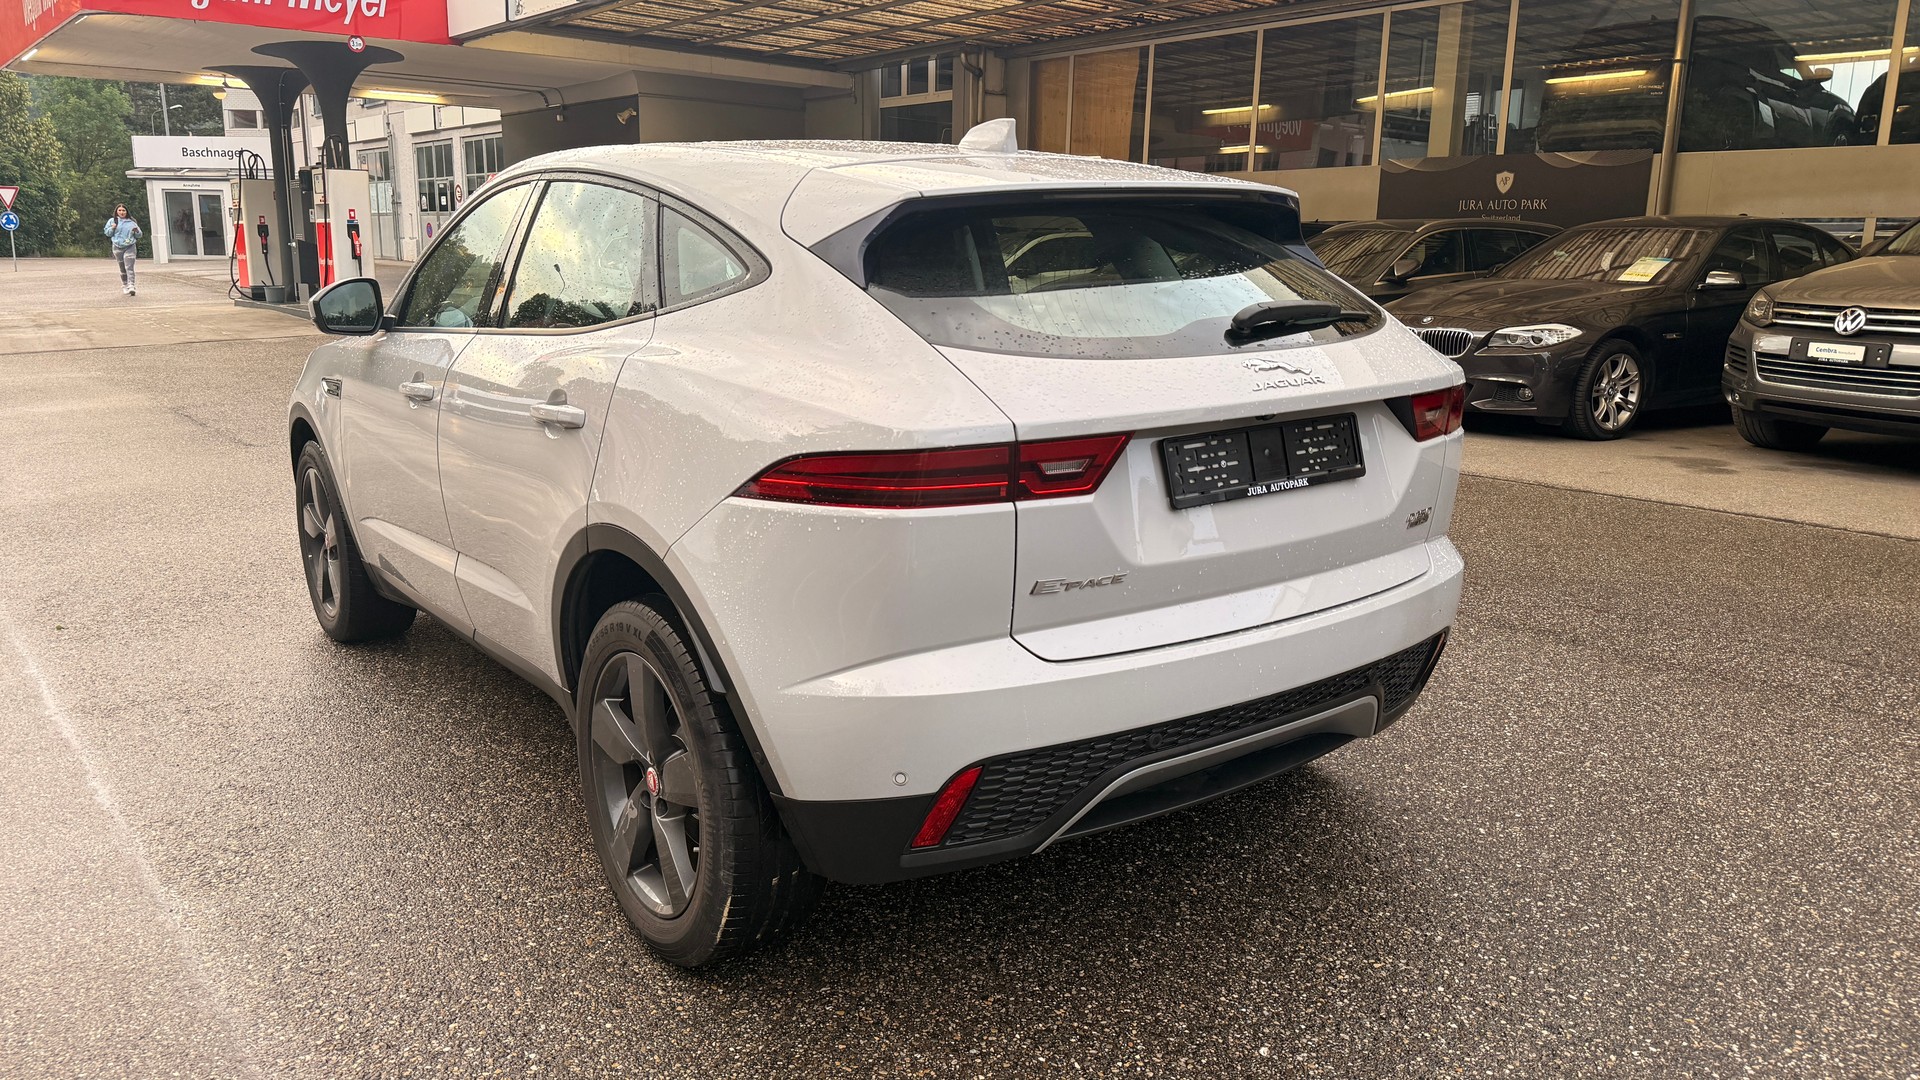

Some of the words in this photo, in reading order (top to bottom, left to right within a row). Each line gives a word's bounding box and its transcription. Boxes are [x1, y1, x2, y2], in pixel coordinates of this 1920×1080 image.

[1459, 199, 1484, 212] JURA
[1487, 199, 1518, 211] AUTO
[1521, 199, 1548, 210] PARK
[1815, 346, 1838, 354] Cembra
[1252, 376, 1326, 392] JAGUAR
[1247, 485, 1268, 496] JURA
[1270, 477, 1310, 492] AUTOPARK
